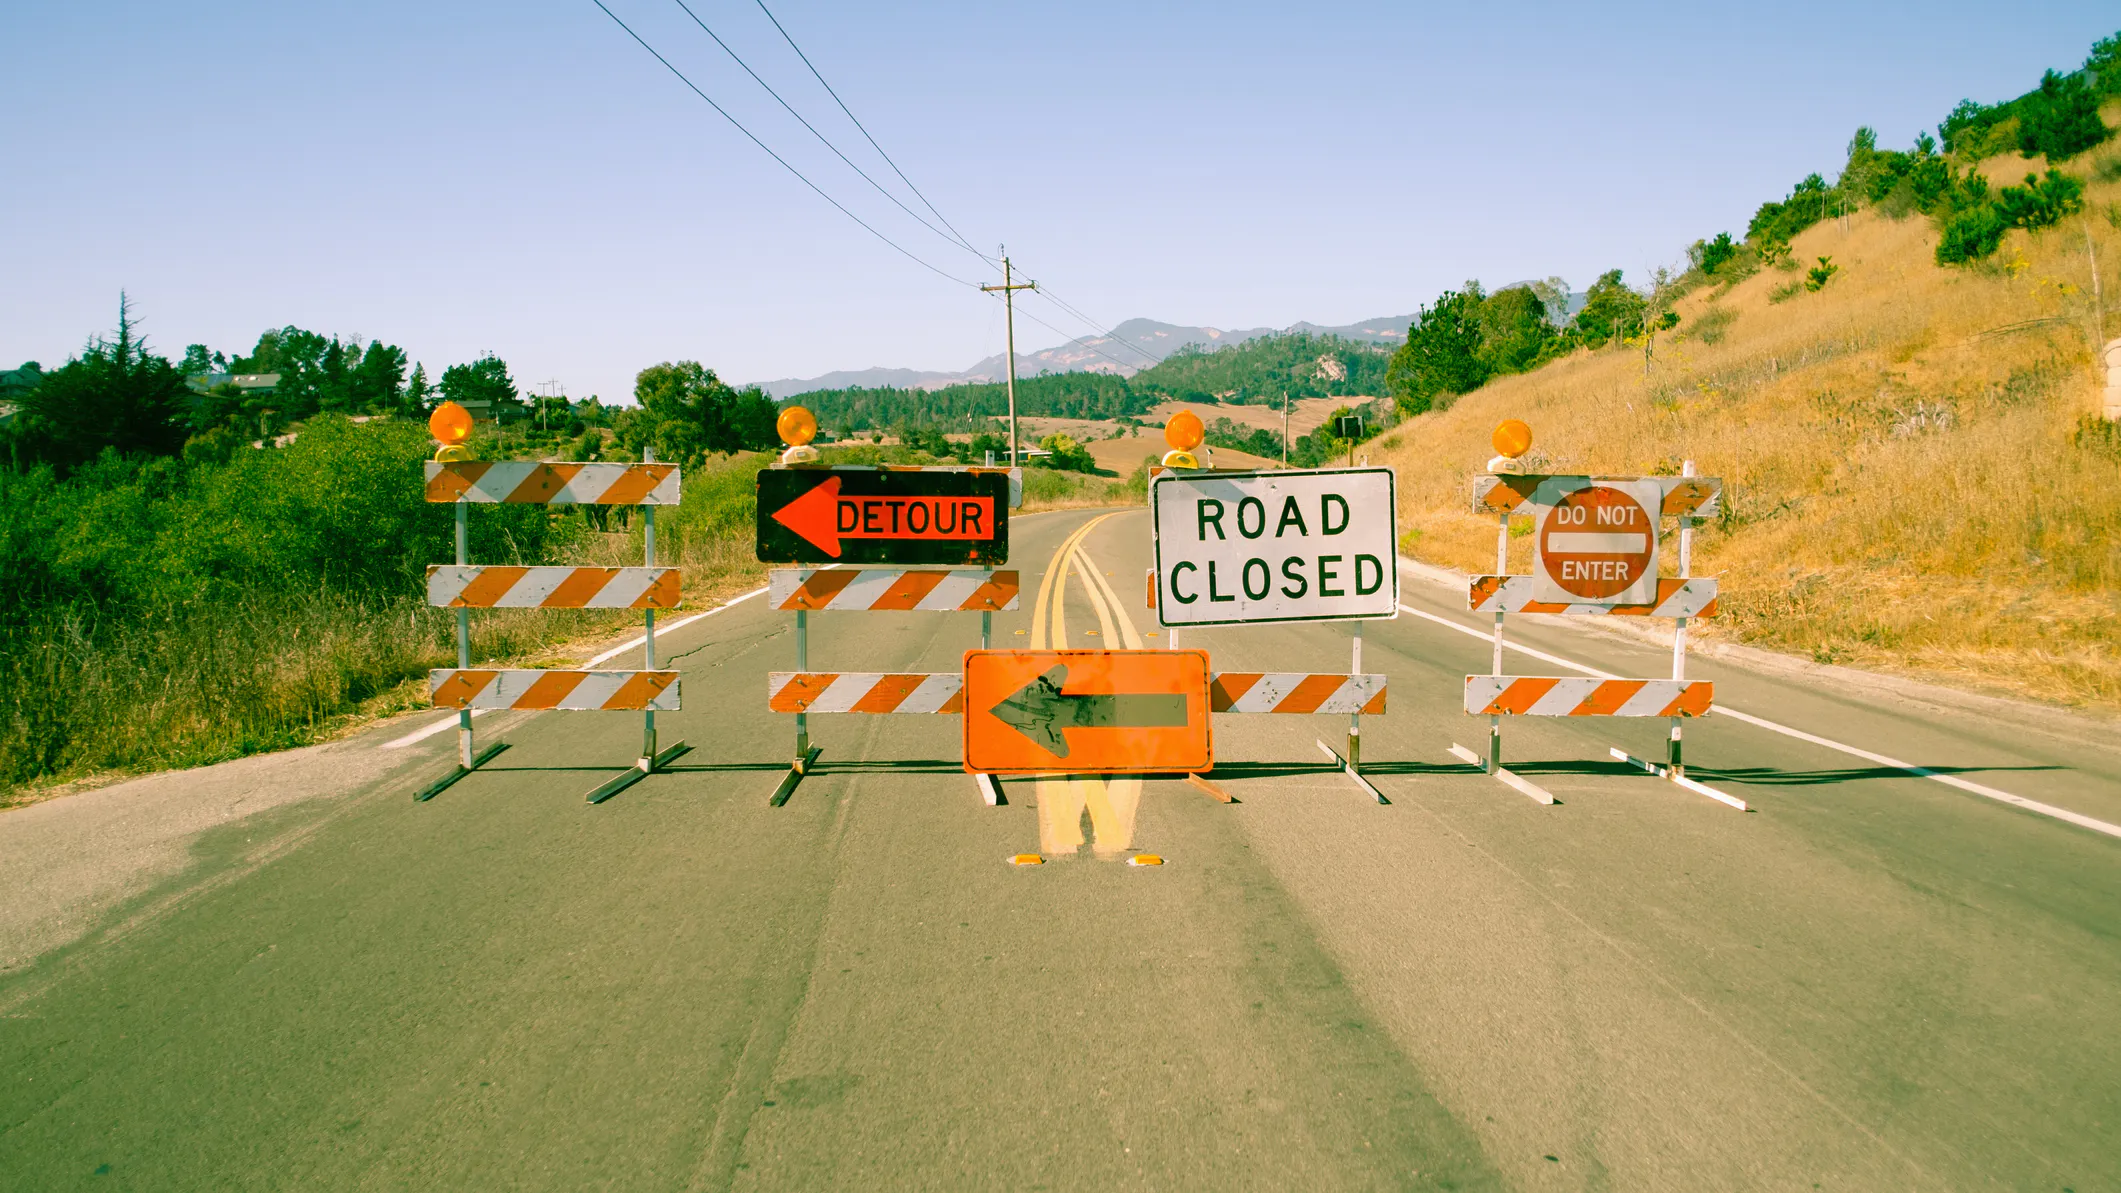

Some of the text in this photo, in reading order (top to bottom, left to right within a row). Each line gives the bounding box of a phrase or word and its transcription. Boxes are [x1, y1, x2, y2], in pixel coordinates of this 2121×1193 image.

[837, 500, 983, 534] DETOUR
[1197, 493, 1350, 541] ROAD
[1557, 505, 1638, 525] DO NOT
[1170, 554, 1384, 604] CLOSED
[1562, 561, 1629, 581] ENTER
